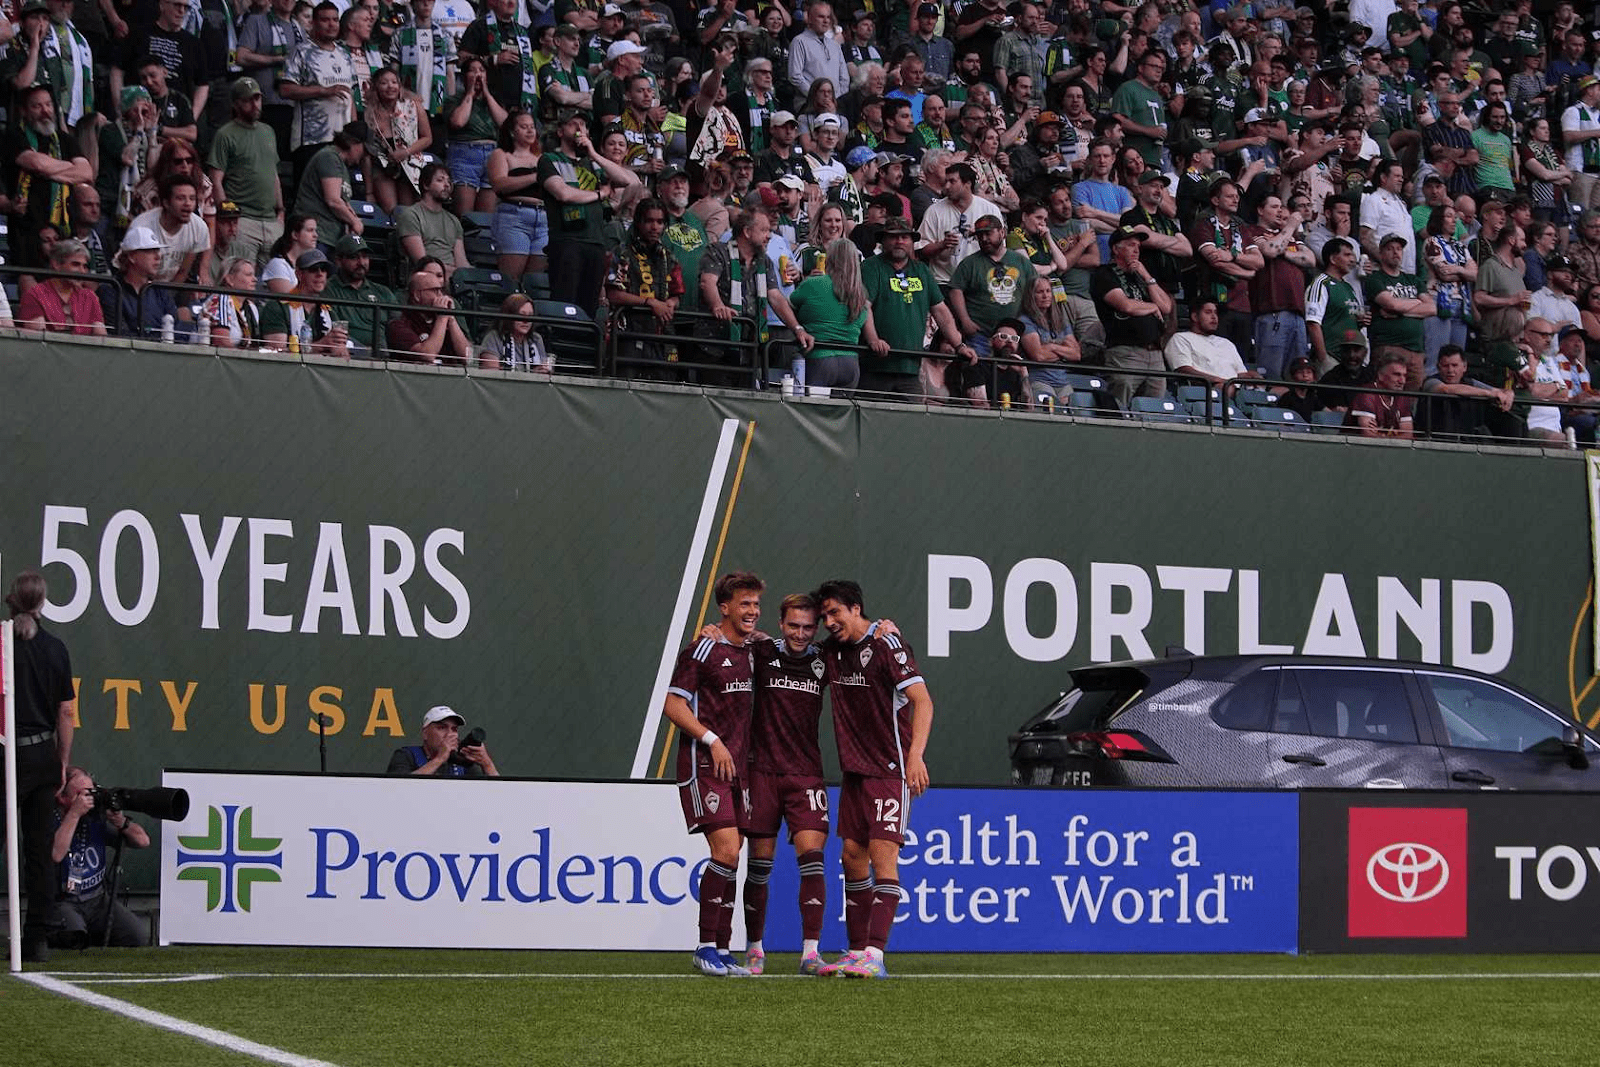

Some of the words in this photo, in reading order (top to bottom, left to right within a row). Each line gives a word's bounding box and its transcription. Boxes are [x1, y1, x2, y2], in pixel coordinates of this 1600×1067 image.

[41, 505, 160, 626] 50
[180, 514, 470, 640] YEARS
[927, 553, 1514, 675] PORTLAND
[249, 684, 404, 737] USA
[769, 675, 821, 695] uchealth
[806, 788, 828, 812] 10
[874, 798, 899, 823] 12
[898, 814, 1040, 867] ealth
[1064, 815, 1149, 867] for
[1172, 831, 1200, 868] a
[839, 874, 1031, 924] etter
